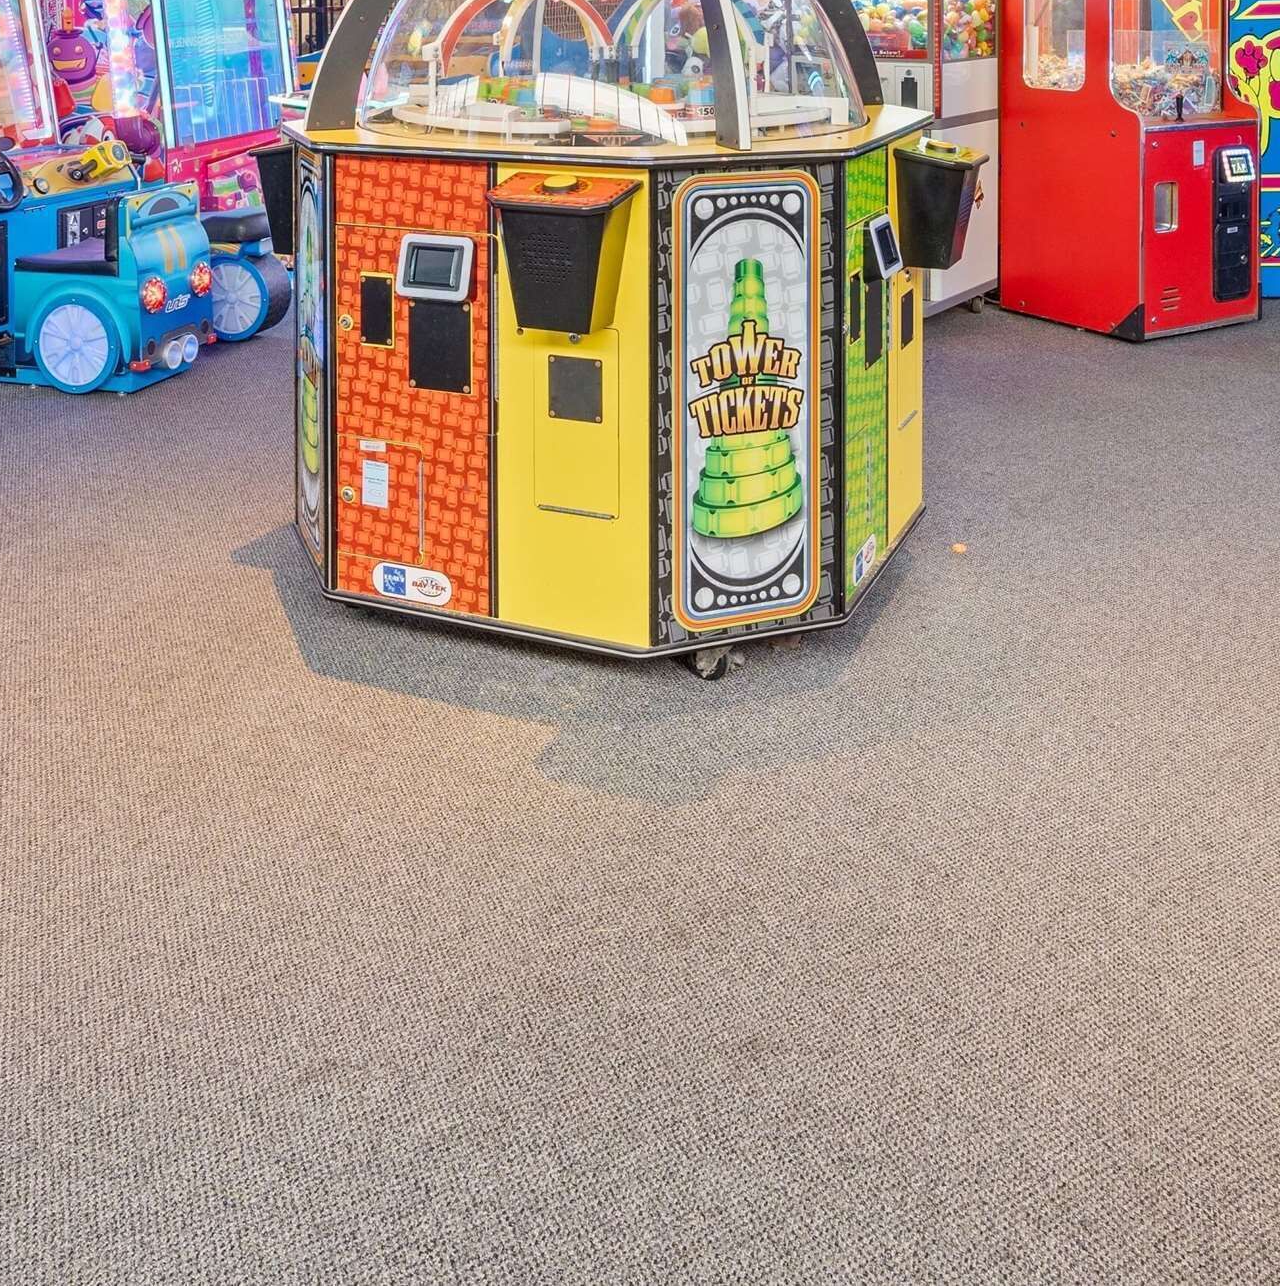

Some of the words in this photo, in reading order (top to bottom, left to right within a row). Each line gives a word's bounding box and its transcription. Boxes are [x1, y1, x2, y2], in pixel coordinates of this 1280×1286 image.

[698, 106, 715, 116] 150
[1231, 163, 1248, 175] TAP
[689, 319, 803, 388] TOWER
[741, 376, 754, 385] OF
[688, 385, 805, 439] TICKETS
[412, 580, 429, 590] BAY
[430, 583, 447, 594] TEK
